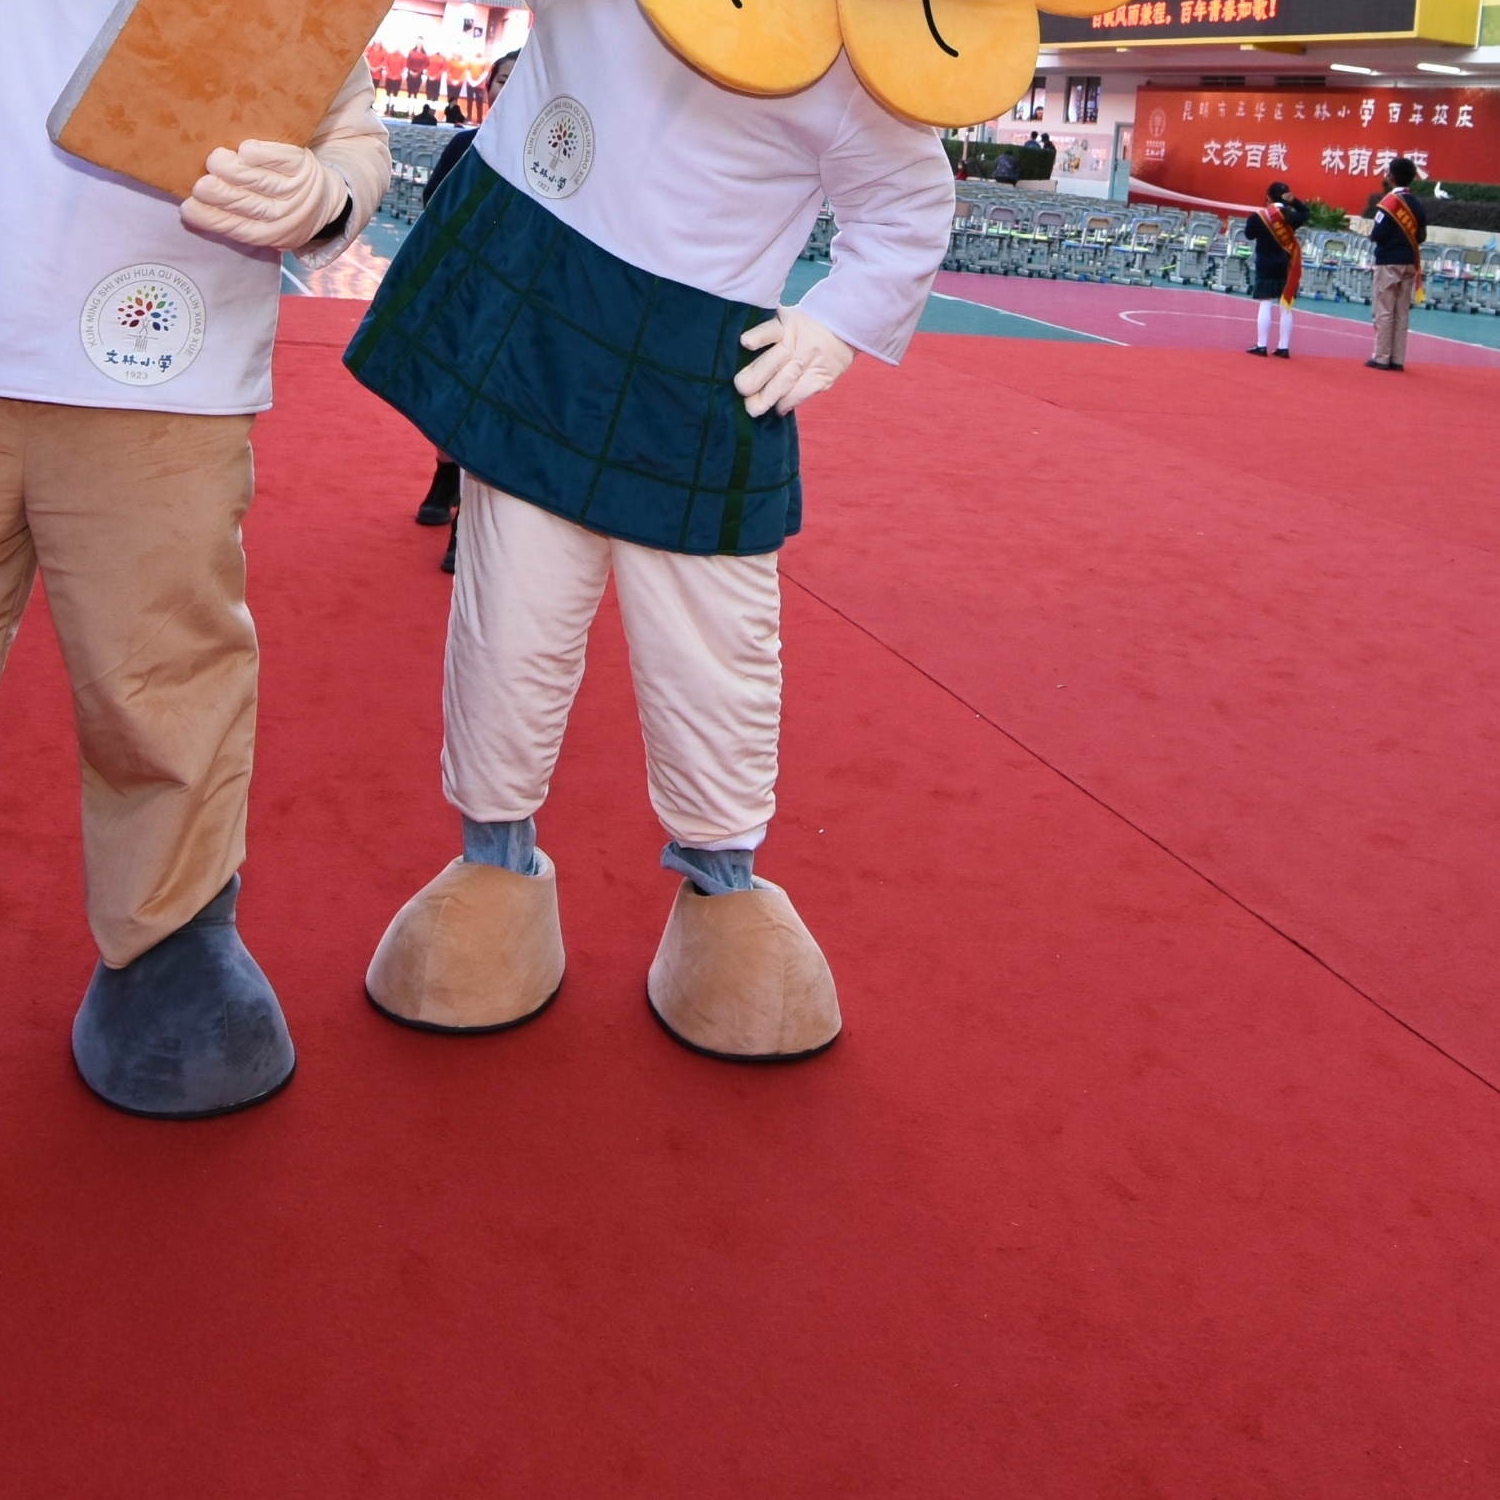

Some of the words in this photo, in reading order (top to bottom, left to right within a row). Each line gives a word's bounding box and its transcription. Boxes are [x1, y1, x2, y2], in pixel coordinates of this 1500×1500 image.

[1202, 138, 1289, 172] 文芳百载
[113, 272, 131, 283] WU
[134, 268, 155, 277] HUA
[158, 269, 173, 280] QU
[98, 281, 115, 297] SHI
[173, 276, 194, 295] WEN
[86, 298, 100, 323] MING
[189, 294, 201, 311] LIN
[193, 311, 202, 335] XIAO
[86, 325, 97, 348] KUN
[184, 337, 200, 358] XUE
[104, 349, 173, 373] 文林小学
[124, 370, 149, 380] 1923
